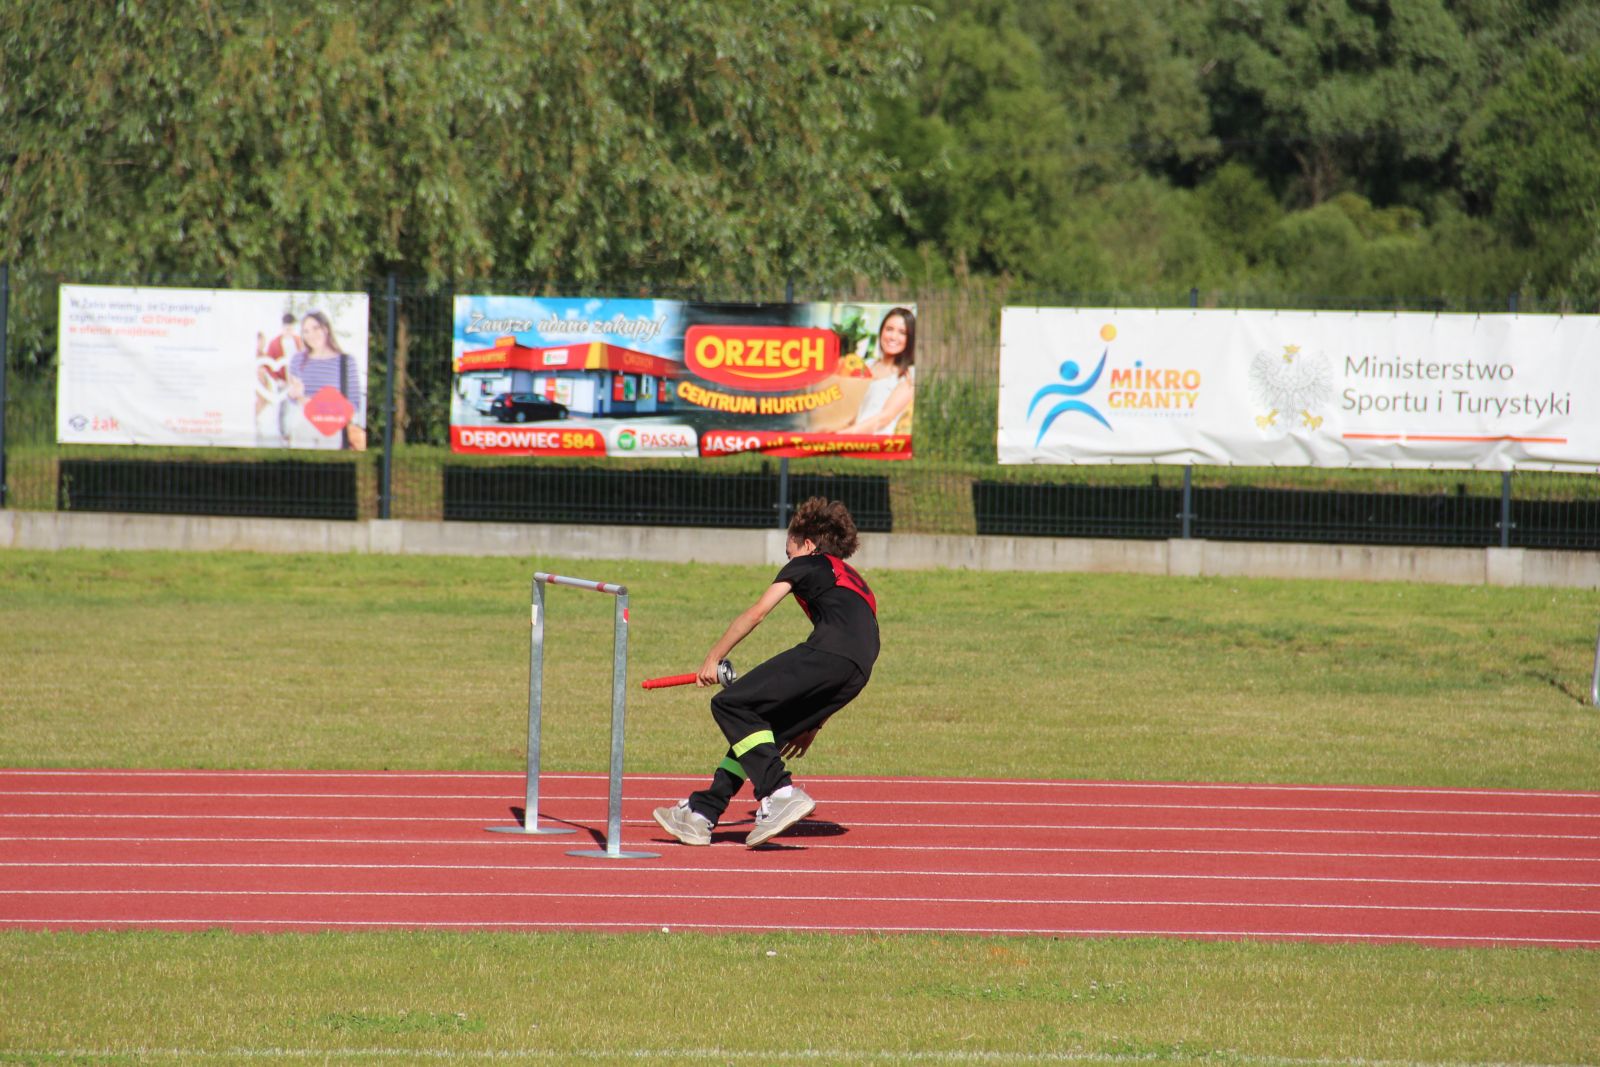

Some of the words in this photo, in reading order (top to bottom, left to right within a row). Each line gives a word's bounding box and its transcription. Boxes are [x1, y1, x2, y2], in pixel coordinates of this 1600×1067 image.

[465, 312, 533, 334] Zawsze
[537, 313, 588, 334] udane
[592, 313, 669, 342] zakupy!
[695, 335, 825, 371] ORZECH
[1344, 355, 1514, 381] Ministerstwo
[677, 381, 758, 415] CENTRUM
[760, 383, 843, 415] HURTOWE
[1107, 391, 1200, 410] GRANTY
[1342, 388, 1428, 415] Sportu
[1437, 390, 1443, 412] i
[1452, 390, 1572, 418] Turystyki
[92, 415, 120, 432] żak
[460, 430, 560, 450] DĘBOWIEC
[562, 433, 596, 449] 584
[641, 434, 689, 448] PASSA
[704, 436, 760, 451] JASŁO
[790, 437, 880, 452] Towarowa
[883, 438, 906, 452] 27
